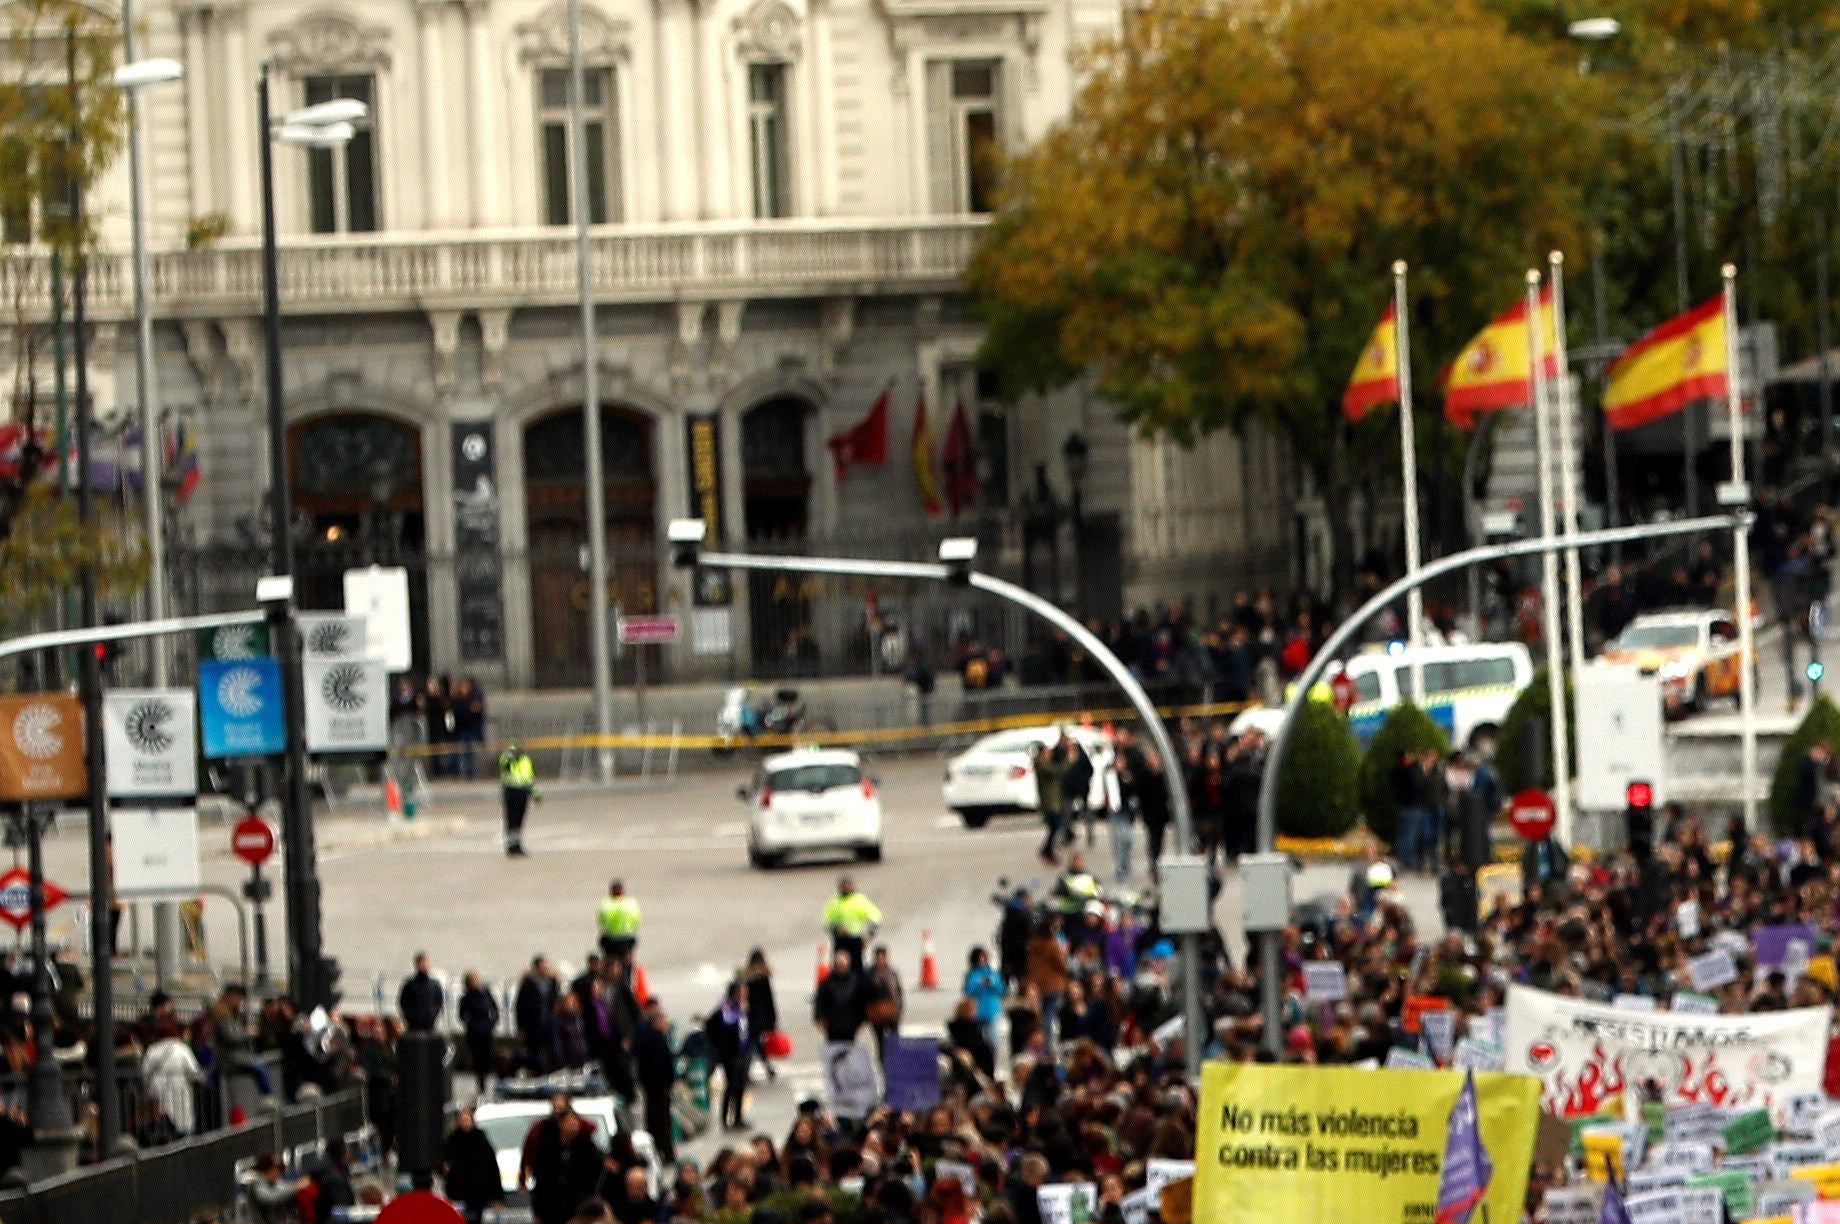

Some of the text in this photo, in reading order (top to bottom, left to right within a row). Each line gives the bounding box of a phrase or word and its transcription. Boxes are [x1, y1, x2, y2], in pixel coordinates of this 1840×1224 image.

[1221, 1105, 1419, 1140] No más violencia
[1219, 1143, 1299, 1170] contra
[1306, 1145, 1338, 1174] las
